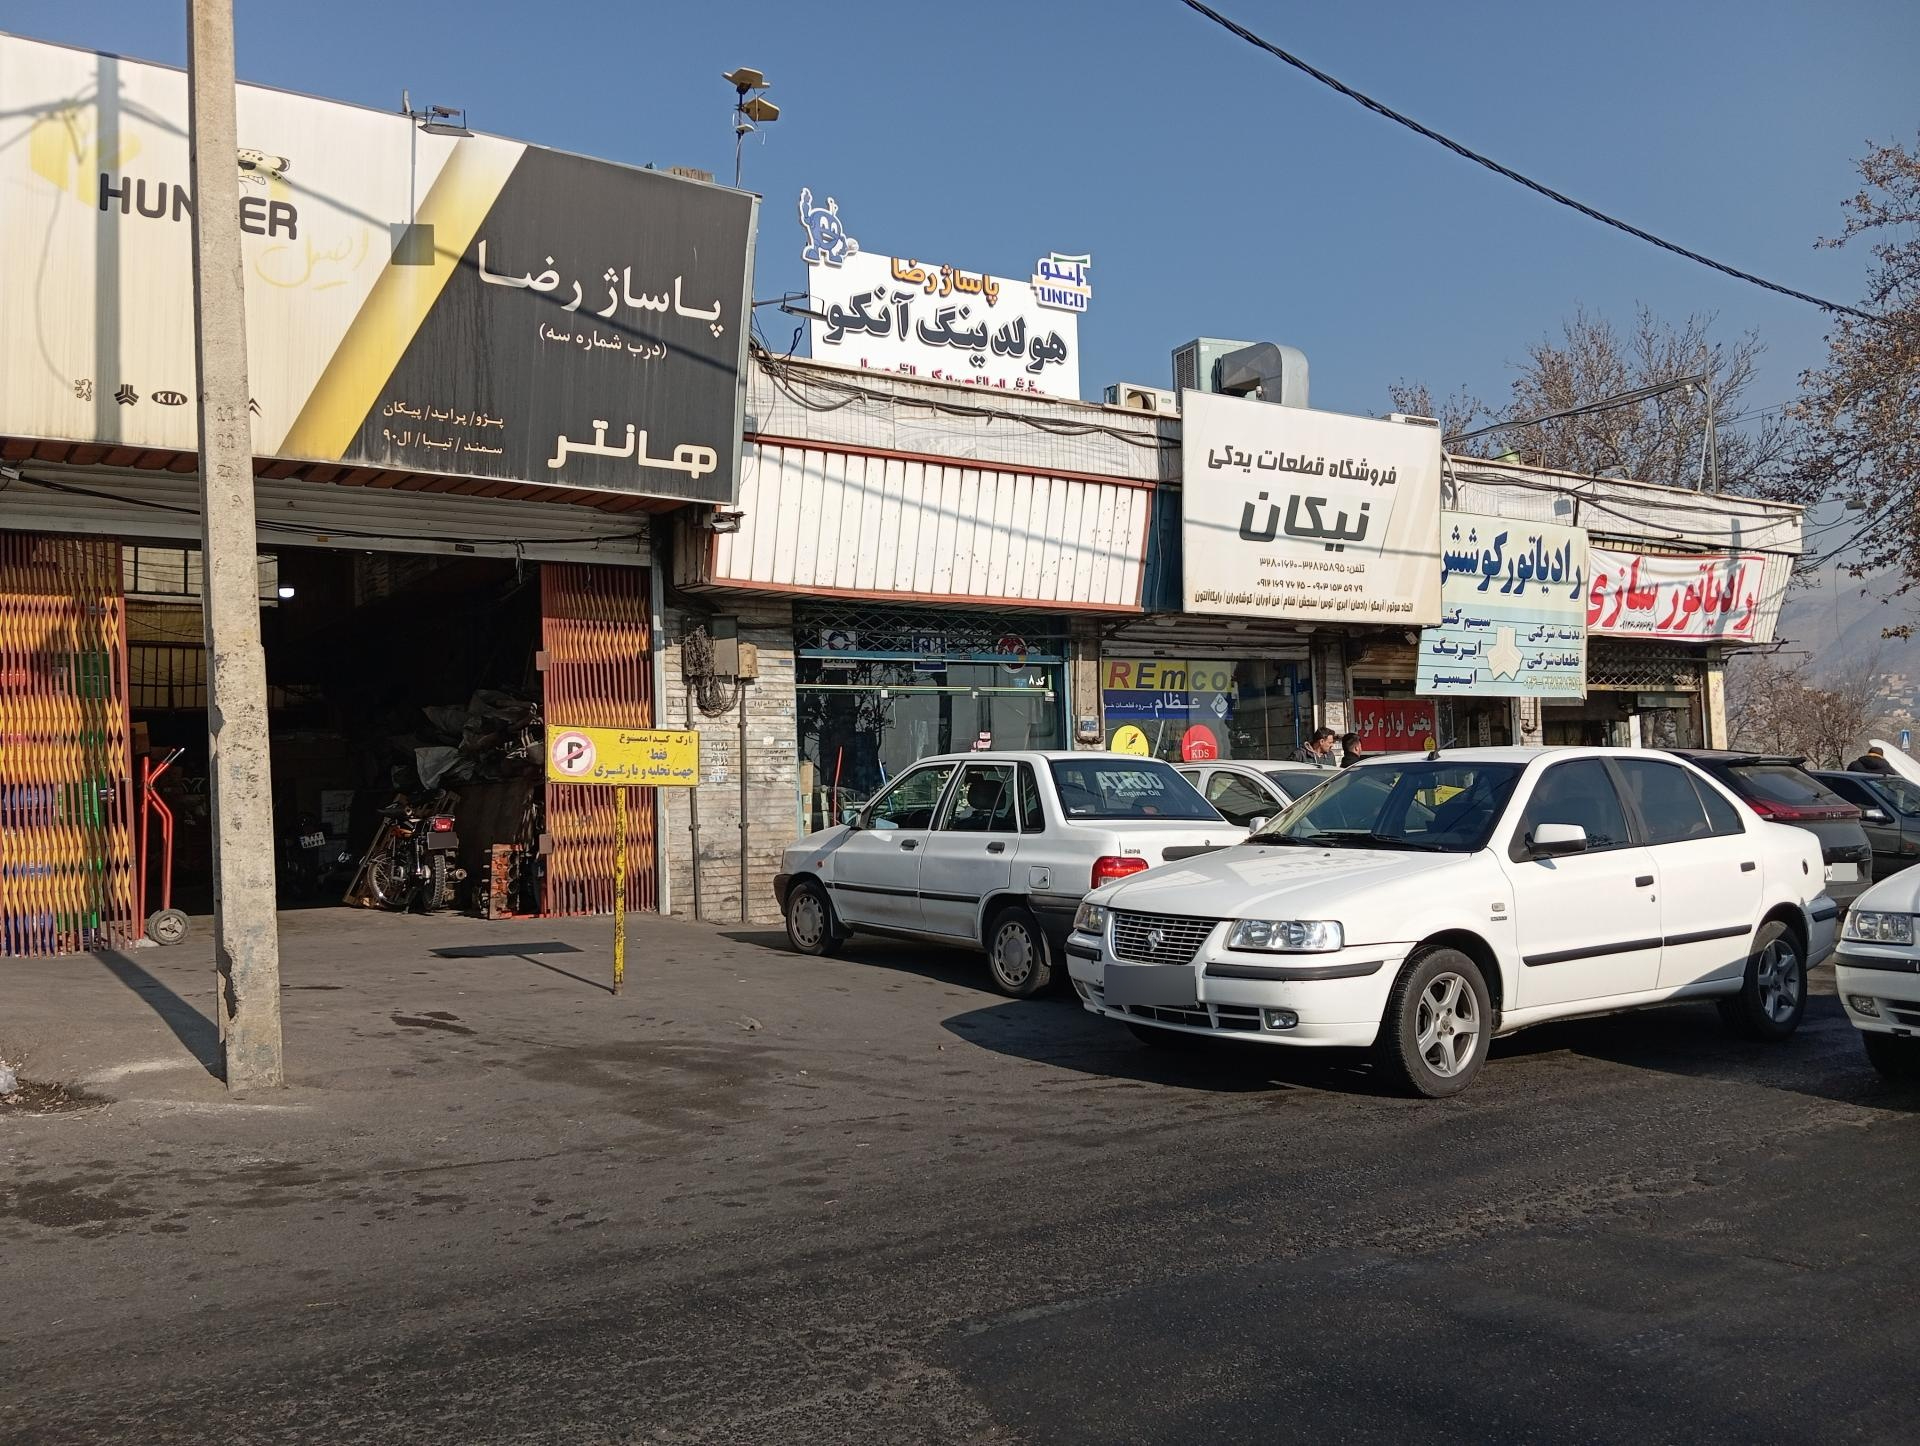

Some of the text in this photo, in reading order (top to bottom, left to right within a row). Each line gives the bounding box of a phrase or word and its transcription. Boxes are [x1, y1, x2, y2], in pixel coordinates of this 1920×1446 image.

[99, 172, 298, 240] HUNER
[477, 239, 724, 338] پاساژ رضا
[890, 256, 1000, 306] پاساژ رضا
[1039, 286, 1085, 308] UNCO
[575, 329, 622, 351] شماره
[823, 286, 1067, 374] هولدینگ آنکو
[383, 401, 422, 420] پیکان
[547, 418, 719, 480] هانتر
[1207, 444, 1397, 486] فروشگاه قطعات یدکی
[1239, 491, 1371, 552] نیکان
[1500, 533, 1582, 600] رادیاتور
[1588, 555, 1755, 632] رادیاتور سازی
[1442, 608, 1491, 631] سیم کش
[1528, 625, 1580, 642] بدنه شرکتی
[1527, 651, 1580, 669] قطعات شرکتی
[1108, 661, 1228, 691] REmco
[1115, 701, 1135, 709] قطعات
[1154, 692, 1201, 718] عظام
[619, 733, 648, 744] ممنوع
[650, 748, 668, 759] فقط
[1191, 749, 1210, 759] KDS
[648, 763, 671, 779] تخلیه
[672, 767, 694, 780] جهت
[1096, 771, 1165, 789] ATROD
[1118, 790, 1147, 798] Engine
